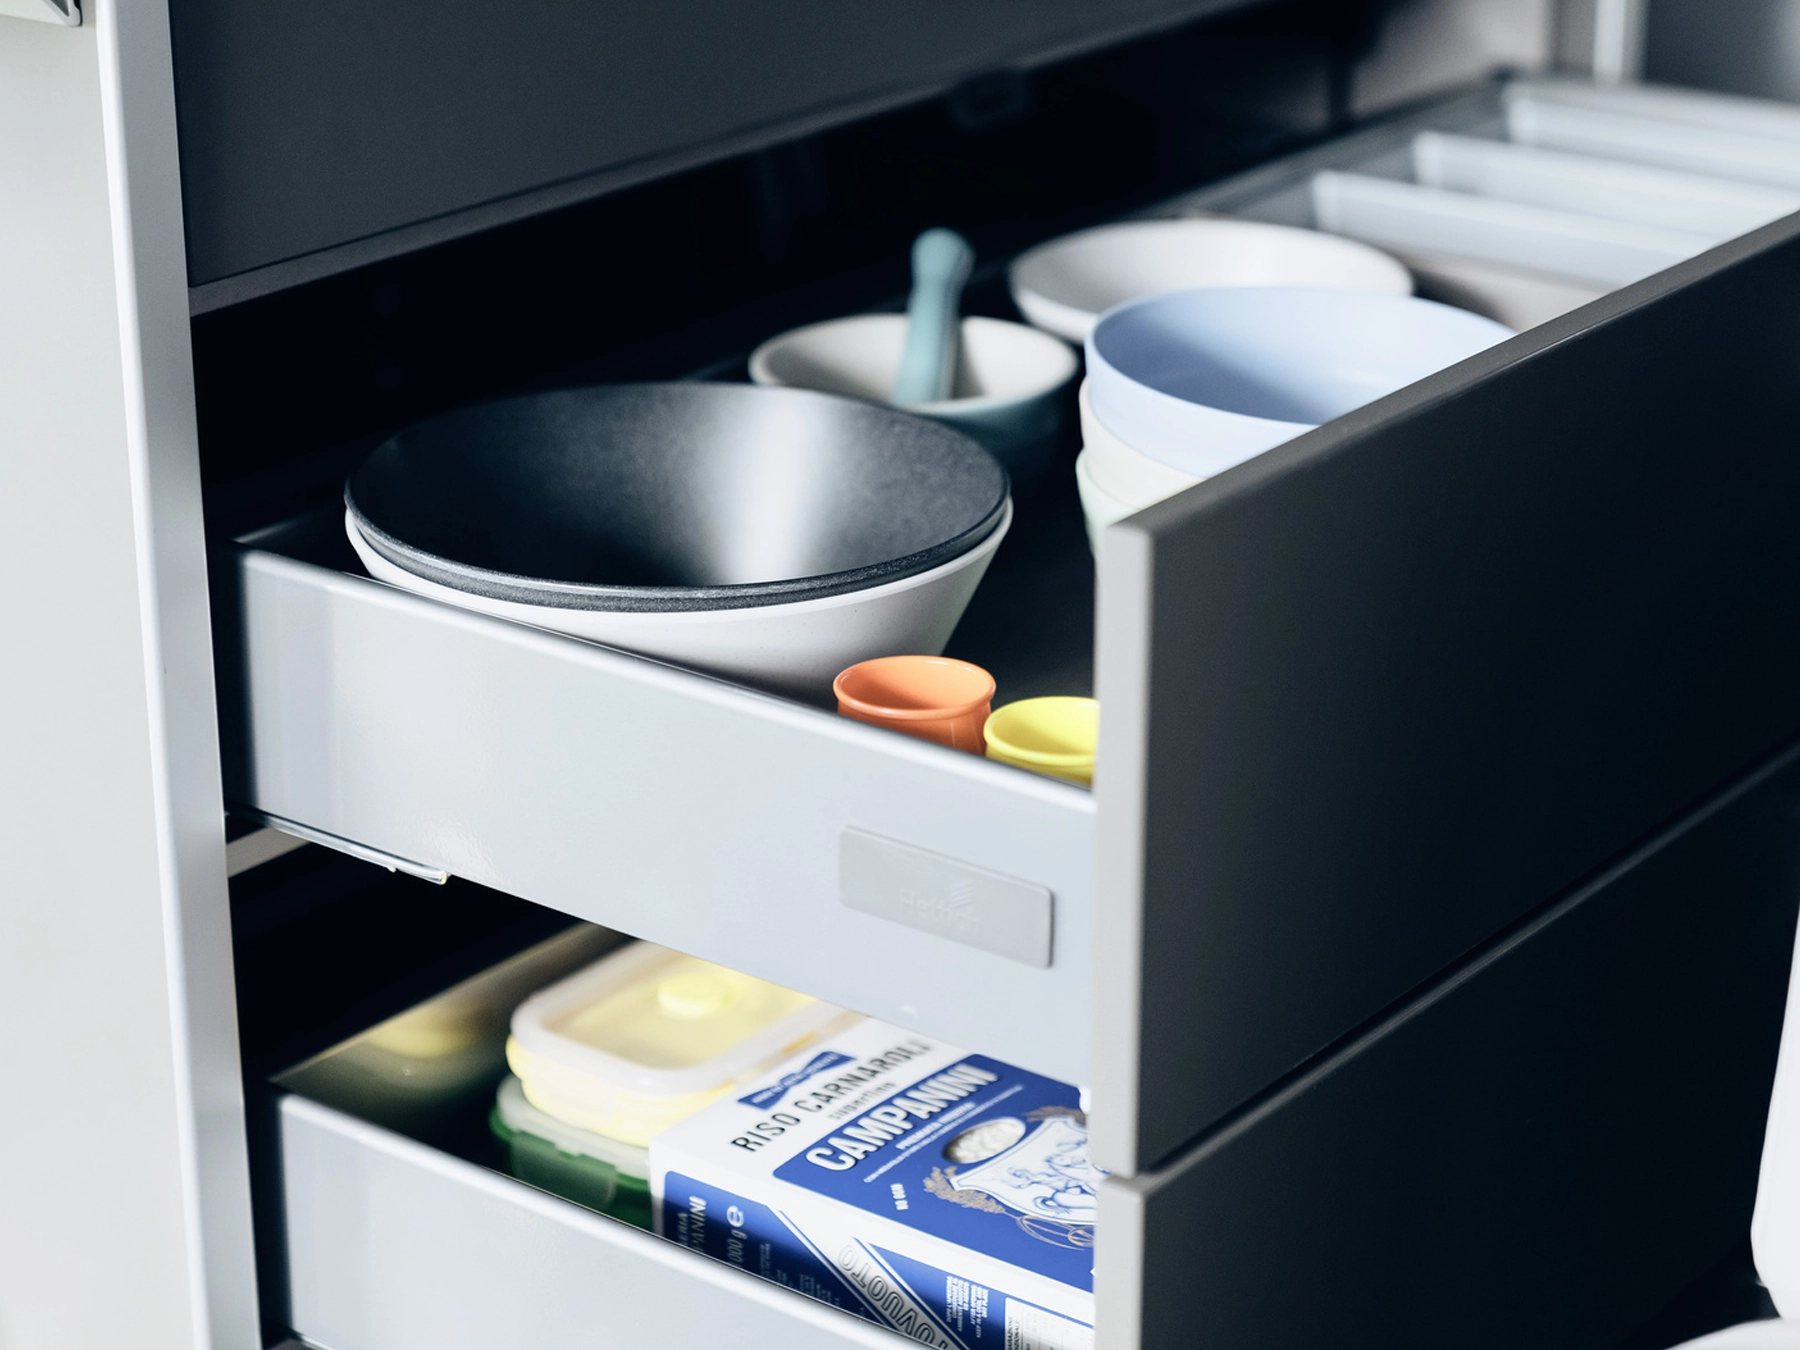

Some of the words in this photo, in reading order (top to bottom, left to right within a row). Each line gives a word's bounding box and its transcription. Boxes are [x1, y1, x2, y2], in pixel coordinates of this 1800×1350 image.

[730, 1112, 801, 1152] RISO
[794, 1039, 931, 1113] CARNAROLI
[806, 1063, 999, 1171] CAMPANINI
[677, 1212, 690, 1247] ERIA
[726, 1238, 744, 1267] 000
